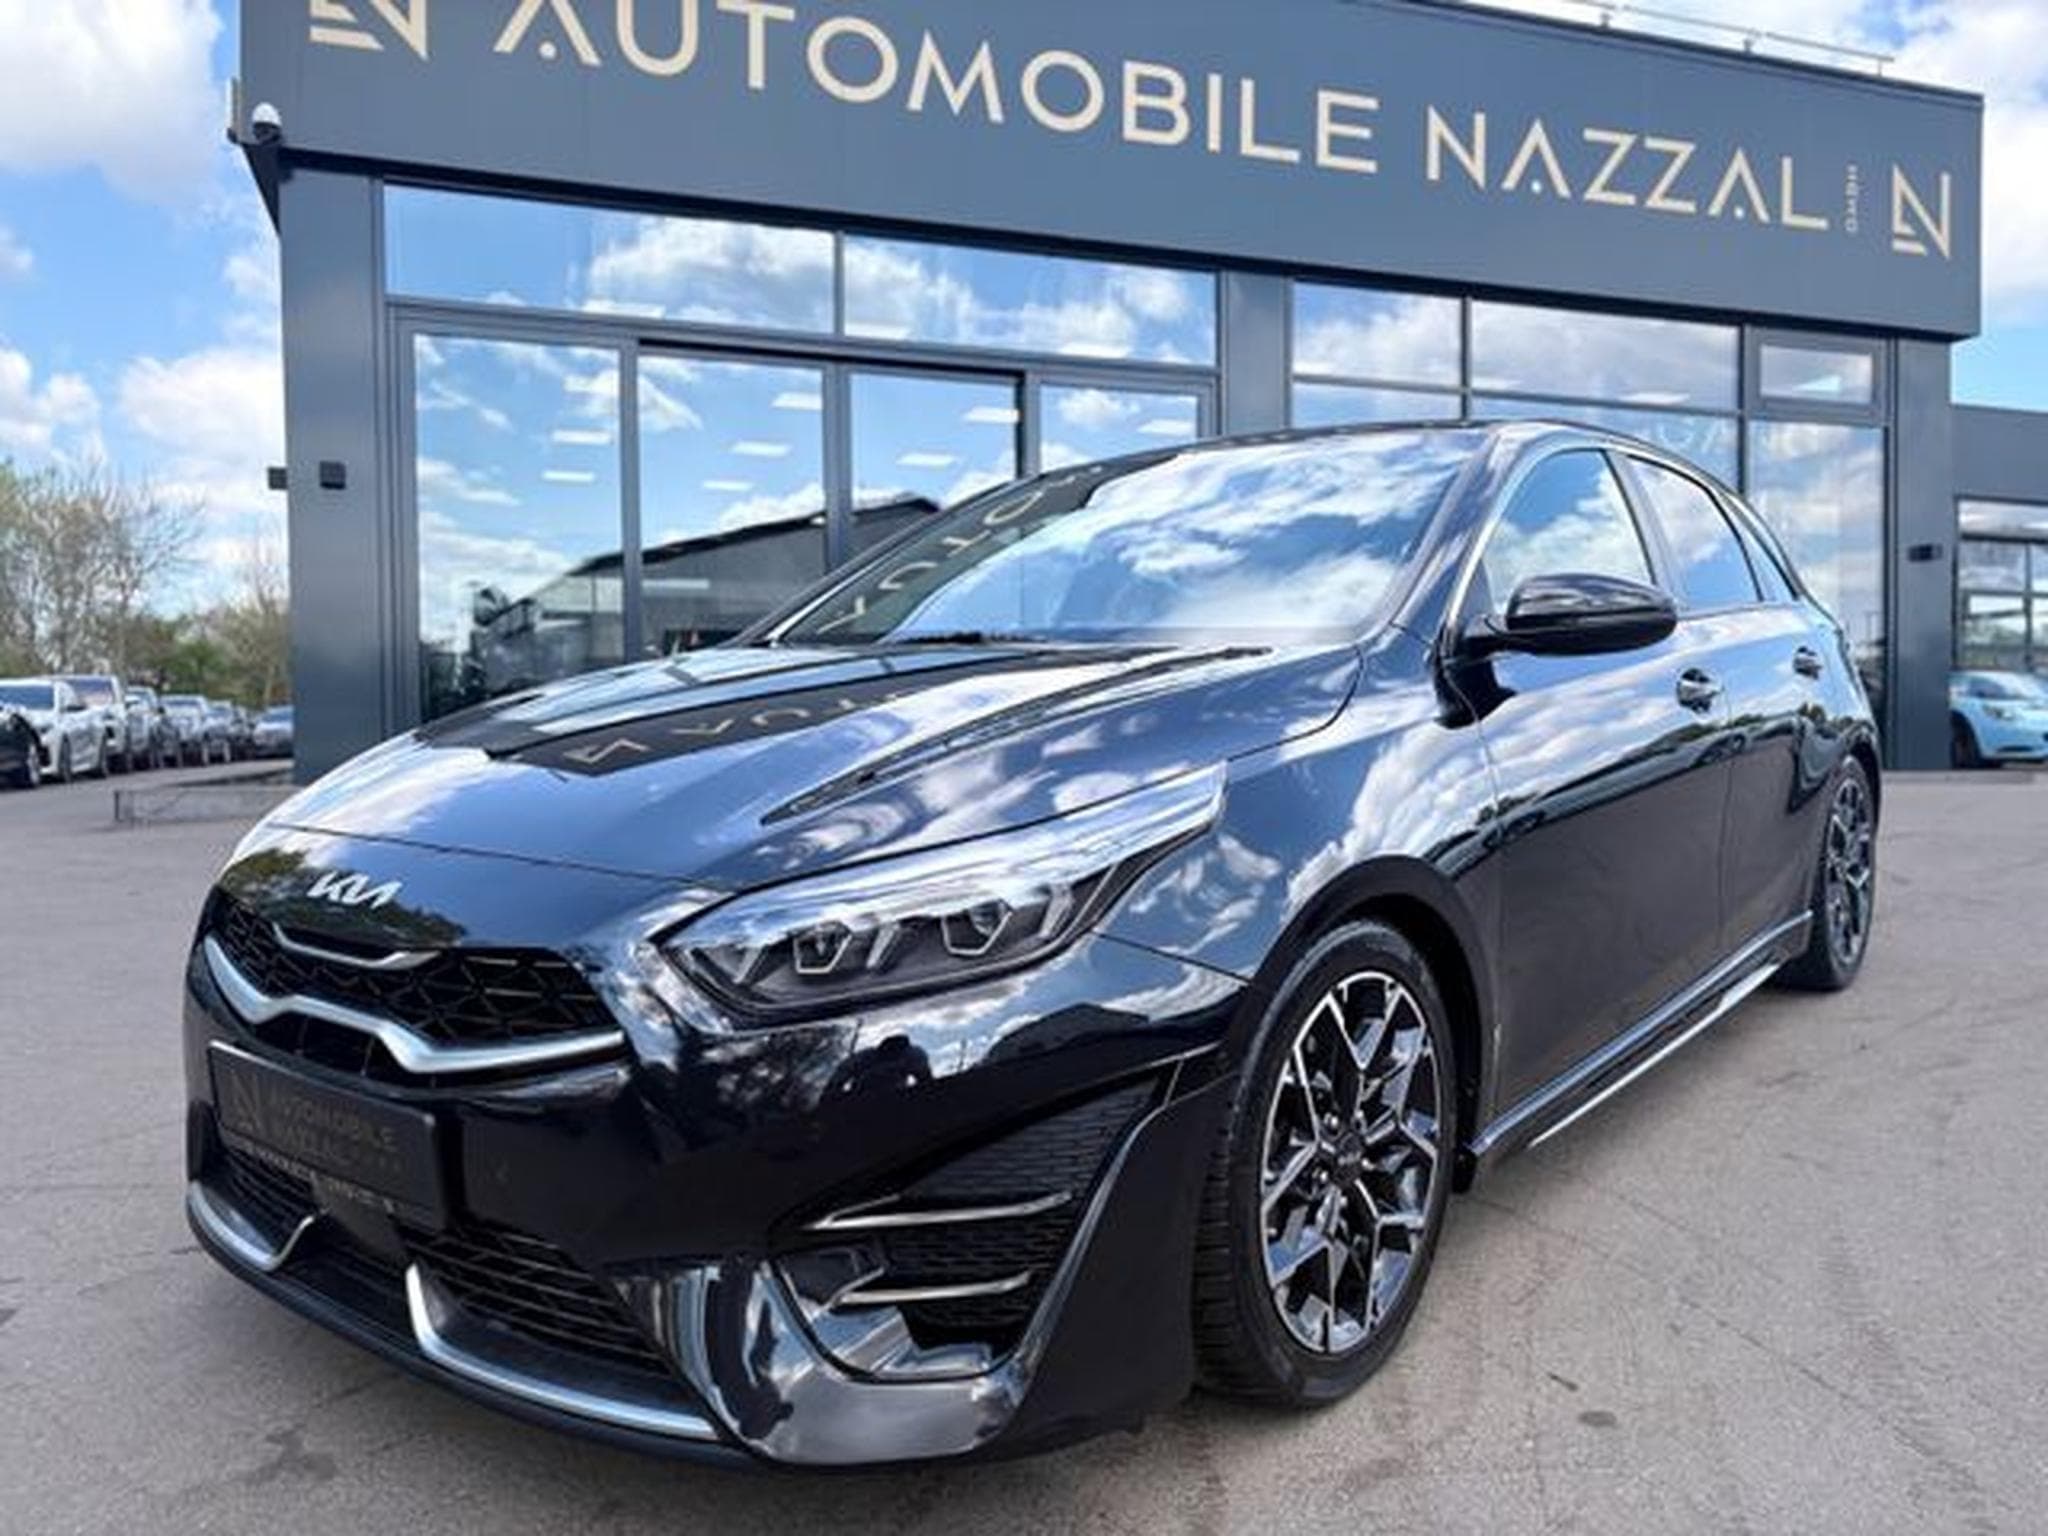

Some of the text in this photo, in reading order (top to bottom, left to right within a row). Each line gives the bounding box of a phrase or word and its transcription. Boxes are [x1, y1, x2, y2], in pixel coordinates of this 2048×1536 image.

[493, 0, 1379, 174] AUTOMOBILE
[1426, 103, 1830, 231] NAZZAL
[306, 871, 403, 910] KIA
